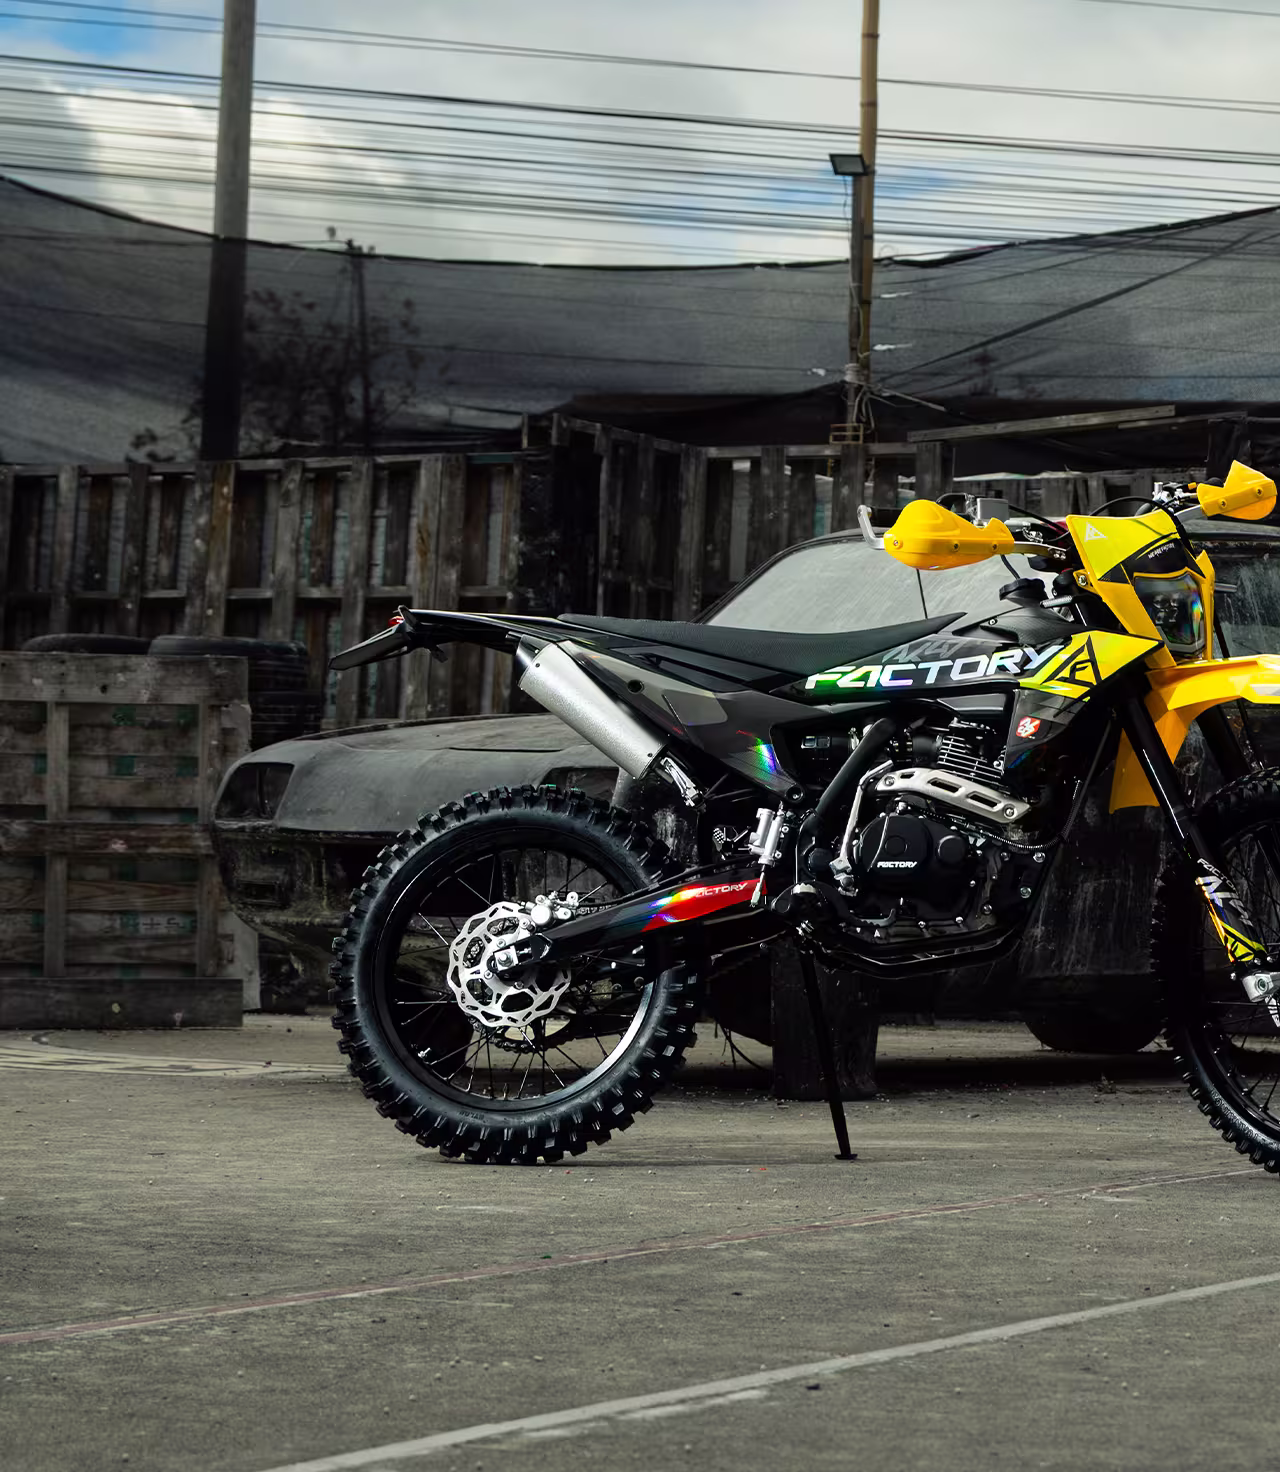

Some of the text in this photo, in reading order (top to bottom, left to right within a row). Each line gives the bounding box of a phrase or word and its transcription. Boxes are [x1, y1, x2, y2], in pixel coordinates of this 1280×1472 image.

[805, 645, 1064, 690] FACTORY
[877, 861, 917, 869] FACTORY
[1197, 858, 1239, 895] FACTO
[684, 882, 748, 898] ACTORY
